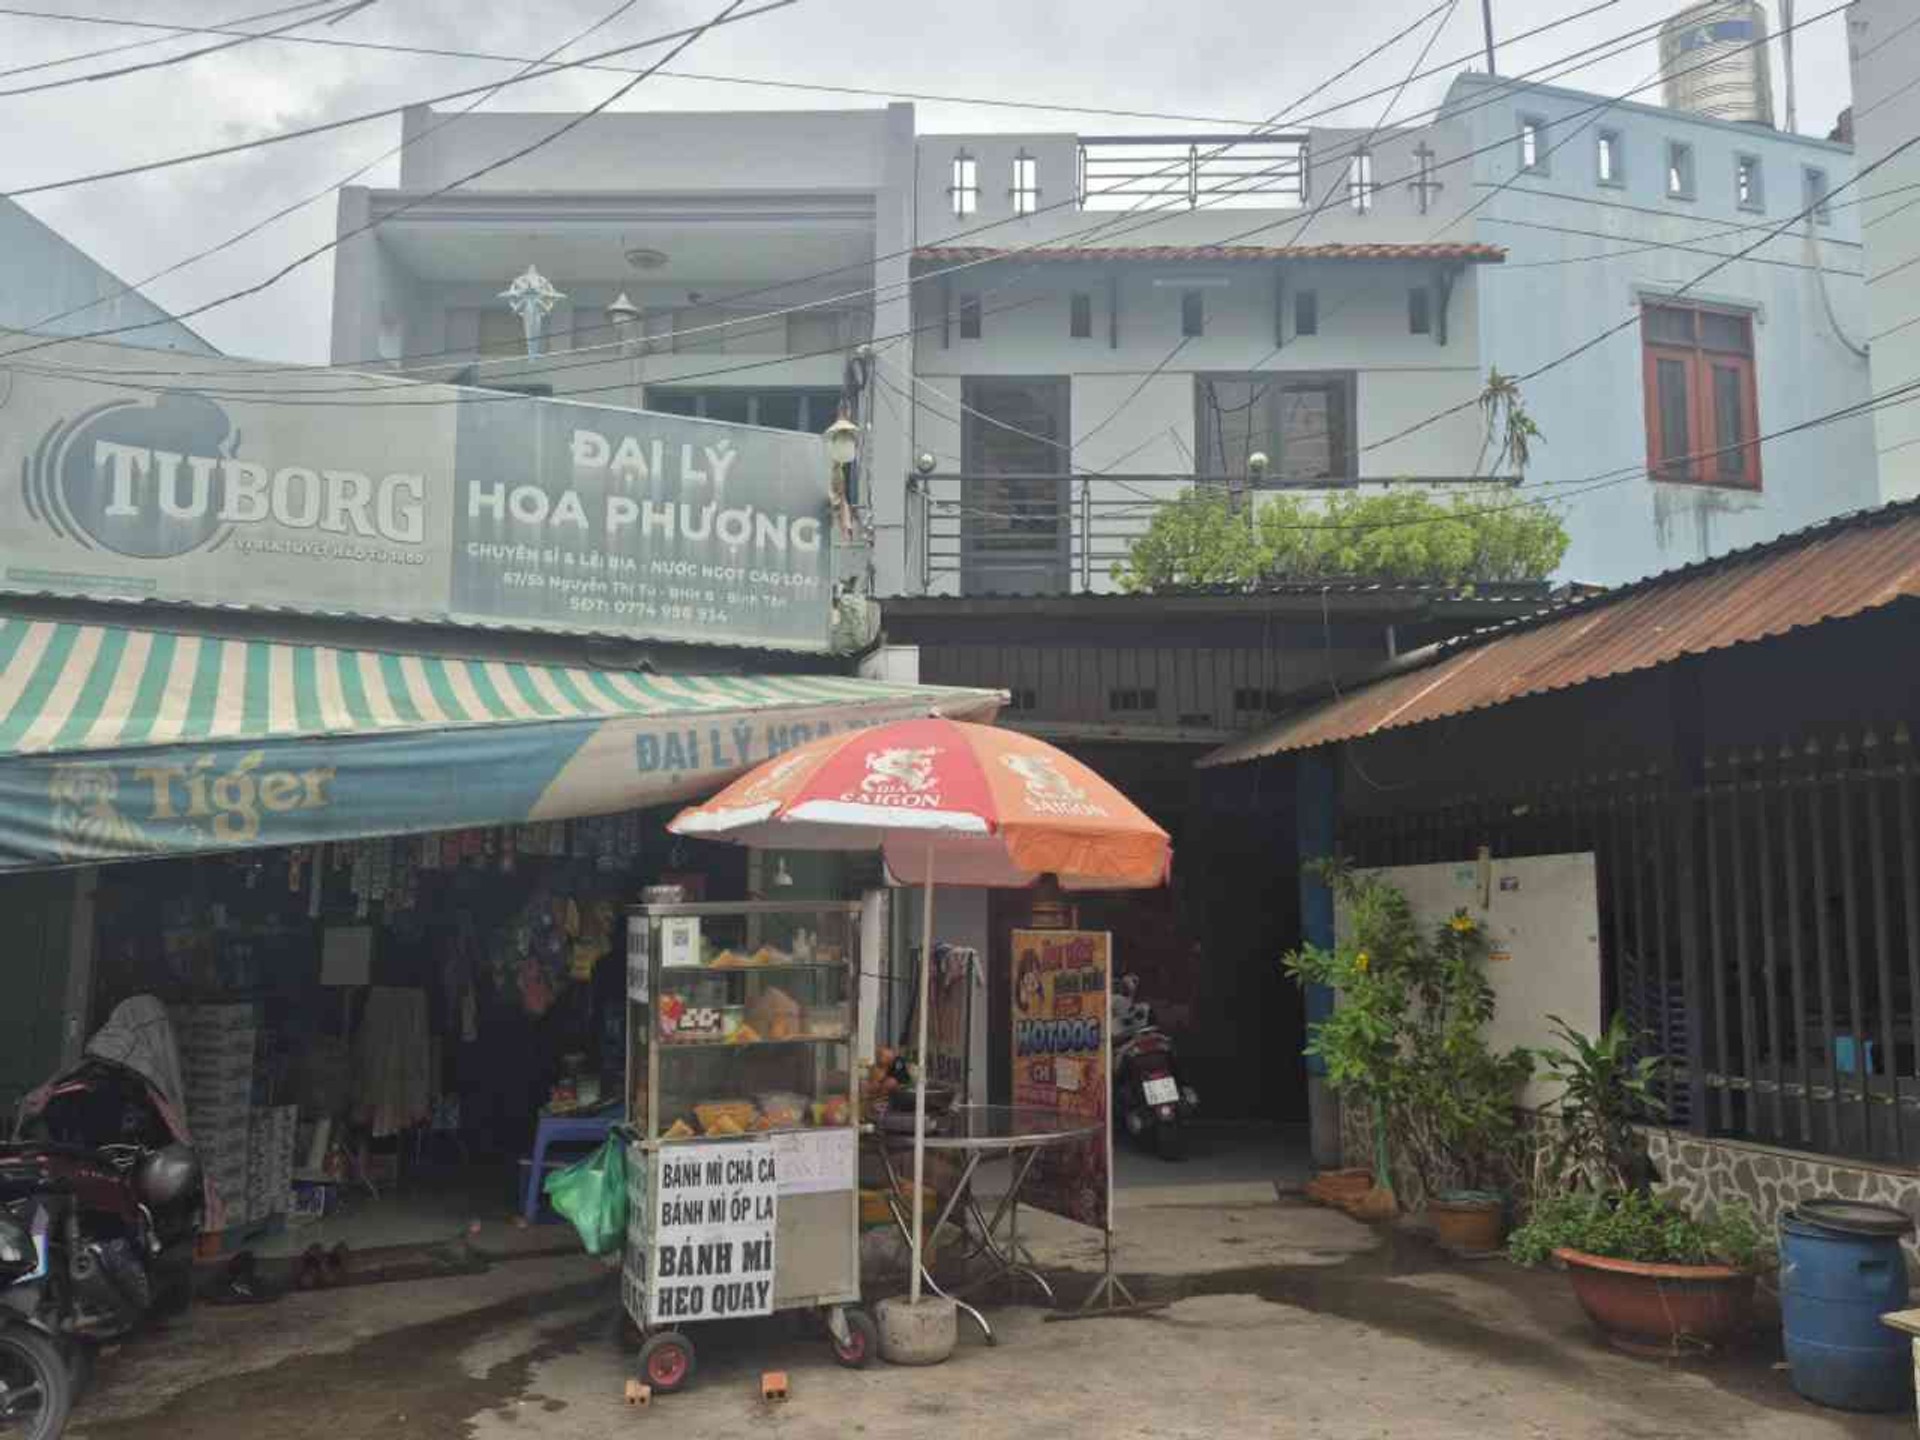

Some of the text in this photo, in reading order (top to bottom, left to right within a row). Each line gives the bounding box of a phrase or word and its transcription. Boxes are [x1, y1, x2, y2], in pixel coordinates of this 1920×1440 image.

[570, 428, 737, 484] ĐẠI LÝ
[94, 439, 427, 543] TUBORG
[467, 480, 822, 555] HOA PHƯỢNG
[635, 729, 699, 780] ĐẠI
[710, 718, 753, 769] LÝ
[133, 749, 337, 843] Tiger
[839, 792, 942, 808] SAIGON
[661, 1155, 702, 1189] BÁNH
[706, 1154, 723, 1187] MÌ
[726, 1150, 754, 1186] CHẢ
[757, 1152, 777, 1183] CÁ
[661, 1193, 704, 1227] BÁNH
[707, 1192, 726, 1224] MÌ
[730, 1188, 751, 1222] ỐP
[756, 1195, 774, 1221] LA
[658, 1230, 773, 1277] BÁNH MÌ
[657, 1279, 771, 1317] HEO QUAY
